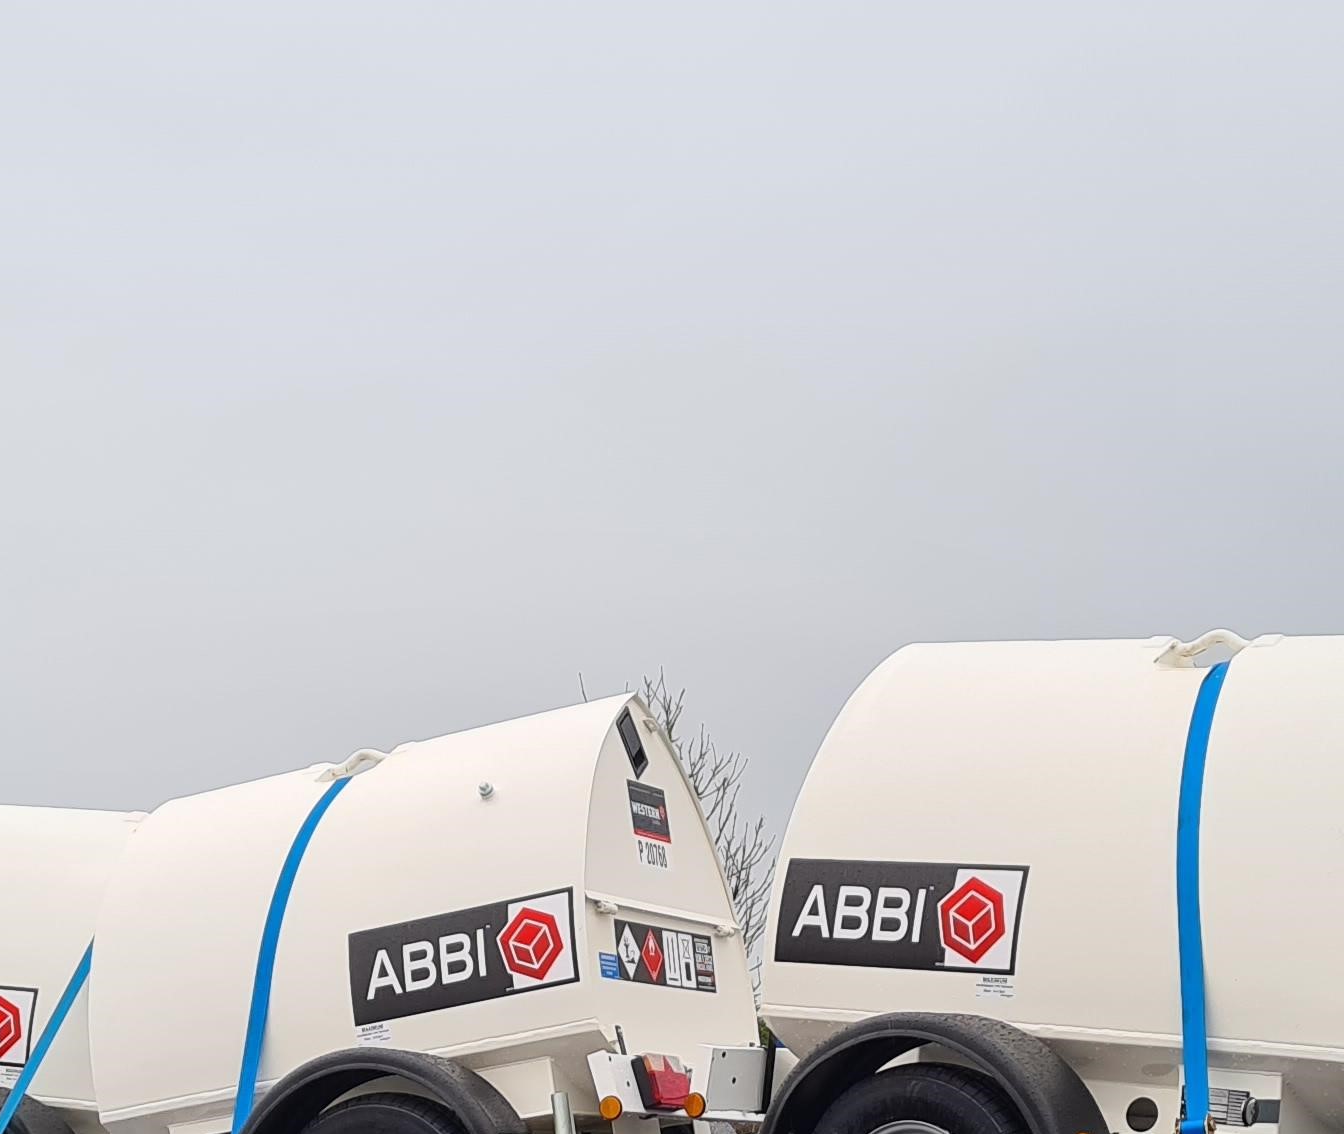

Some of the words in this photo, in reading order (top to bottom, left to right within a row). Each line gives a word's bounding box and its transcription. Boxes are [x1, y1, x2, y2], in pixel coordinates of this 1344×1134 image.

[637, 839, 644, 862] P
[791, 884, 928, 943] ABBI
[366, 927, 488, 1001] ABBI
